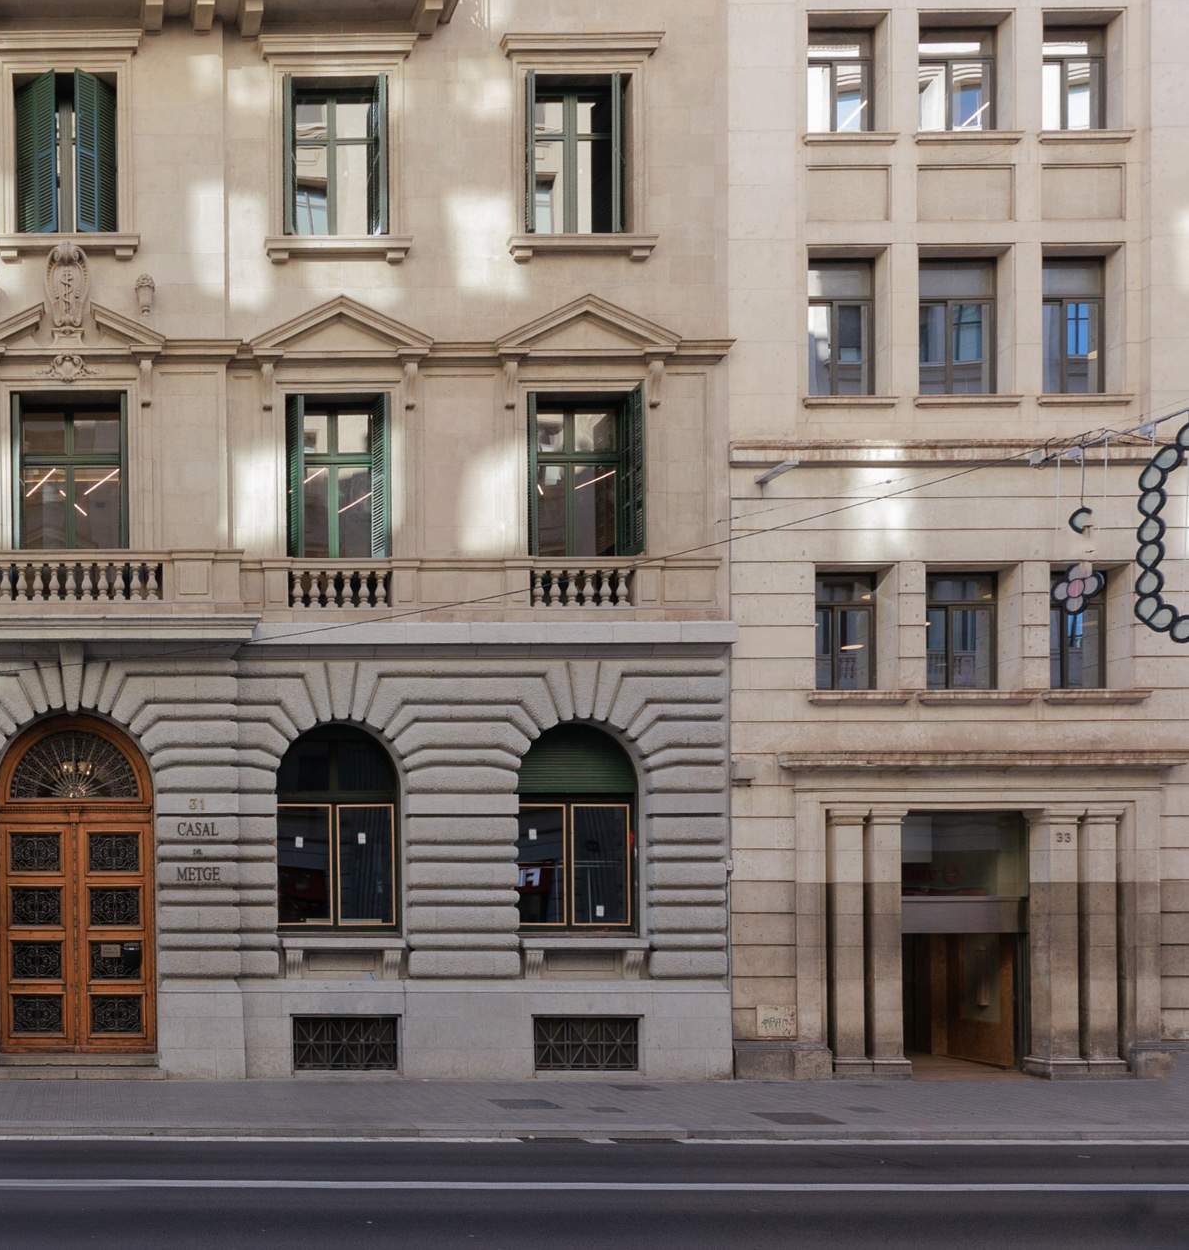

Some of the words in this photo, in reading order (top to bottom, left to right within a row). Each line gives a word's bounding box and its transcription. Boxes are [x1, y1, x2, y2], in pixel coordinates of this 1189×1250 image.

[177, 821, 220, 837] CASAL
[1055, 832, 1072, 843] 33
[176, 866, 221, 882] METGE
